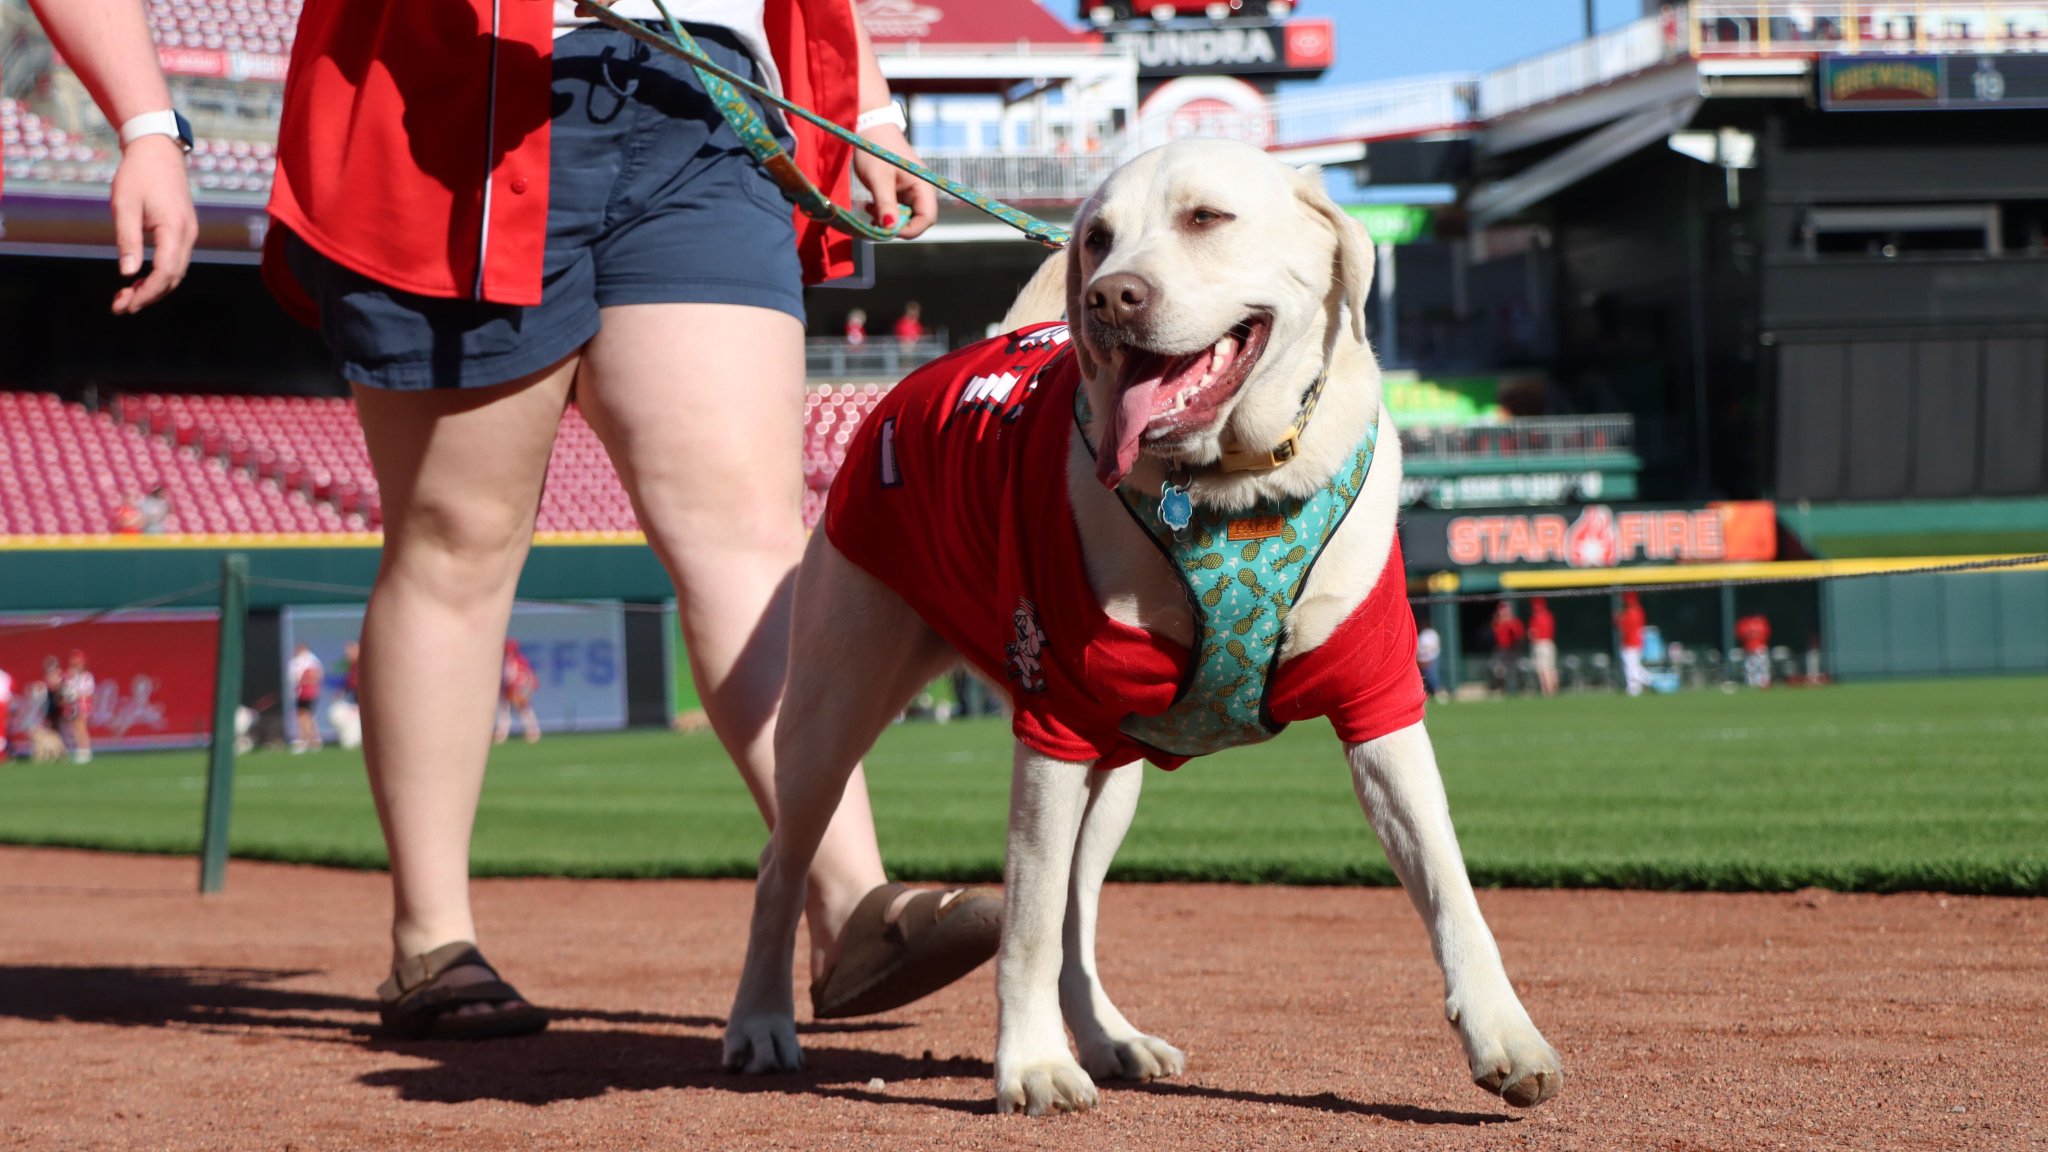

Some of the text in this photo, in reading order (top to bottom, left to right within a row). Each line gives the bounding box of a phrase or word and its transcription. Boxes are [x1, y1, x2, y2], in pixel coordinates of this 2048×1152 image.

[1113, 28, 1276, 67] TUNDRA
[1448, 509, 1725, 564] STAR FIRE
